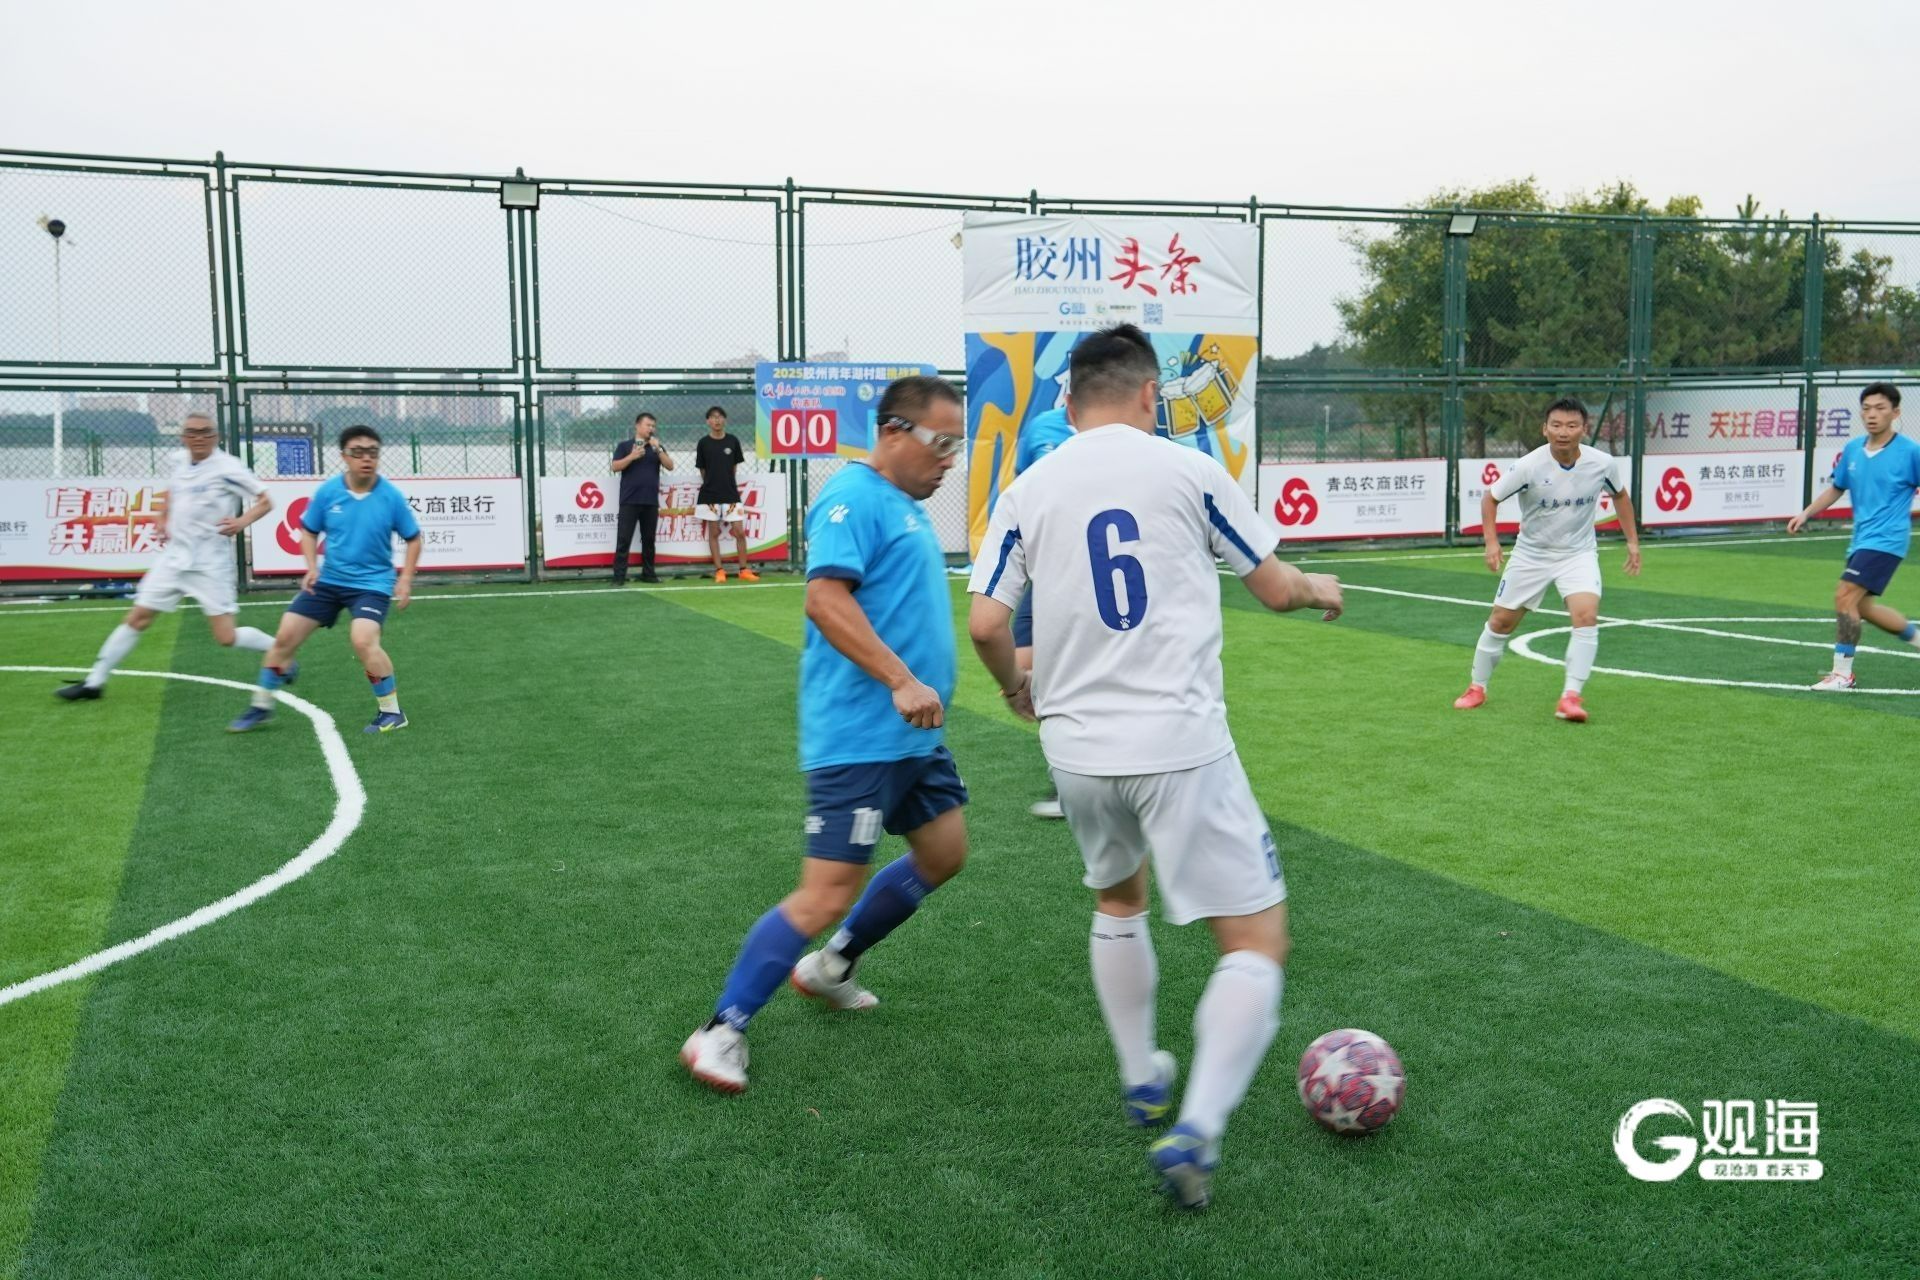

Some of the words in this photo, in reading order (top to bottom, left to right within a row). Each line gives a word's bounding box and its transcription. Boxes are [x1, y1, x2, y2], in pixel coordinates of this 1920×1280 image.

[1014, 232, 1202, 297] 胶州头条
[1326, 474, 1426, 492] 青岛农商银行
[1699, 463, 1786, 480] 青岛农商银行
[658, 480, 767, 514] 农商力
[1356, 503, 1397, 517] 胶州支行
[1086, 508, 1149, 632] 6
